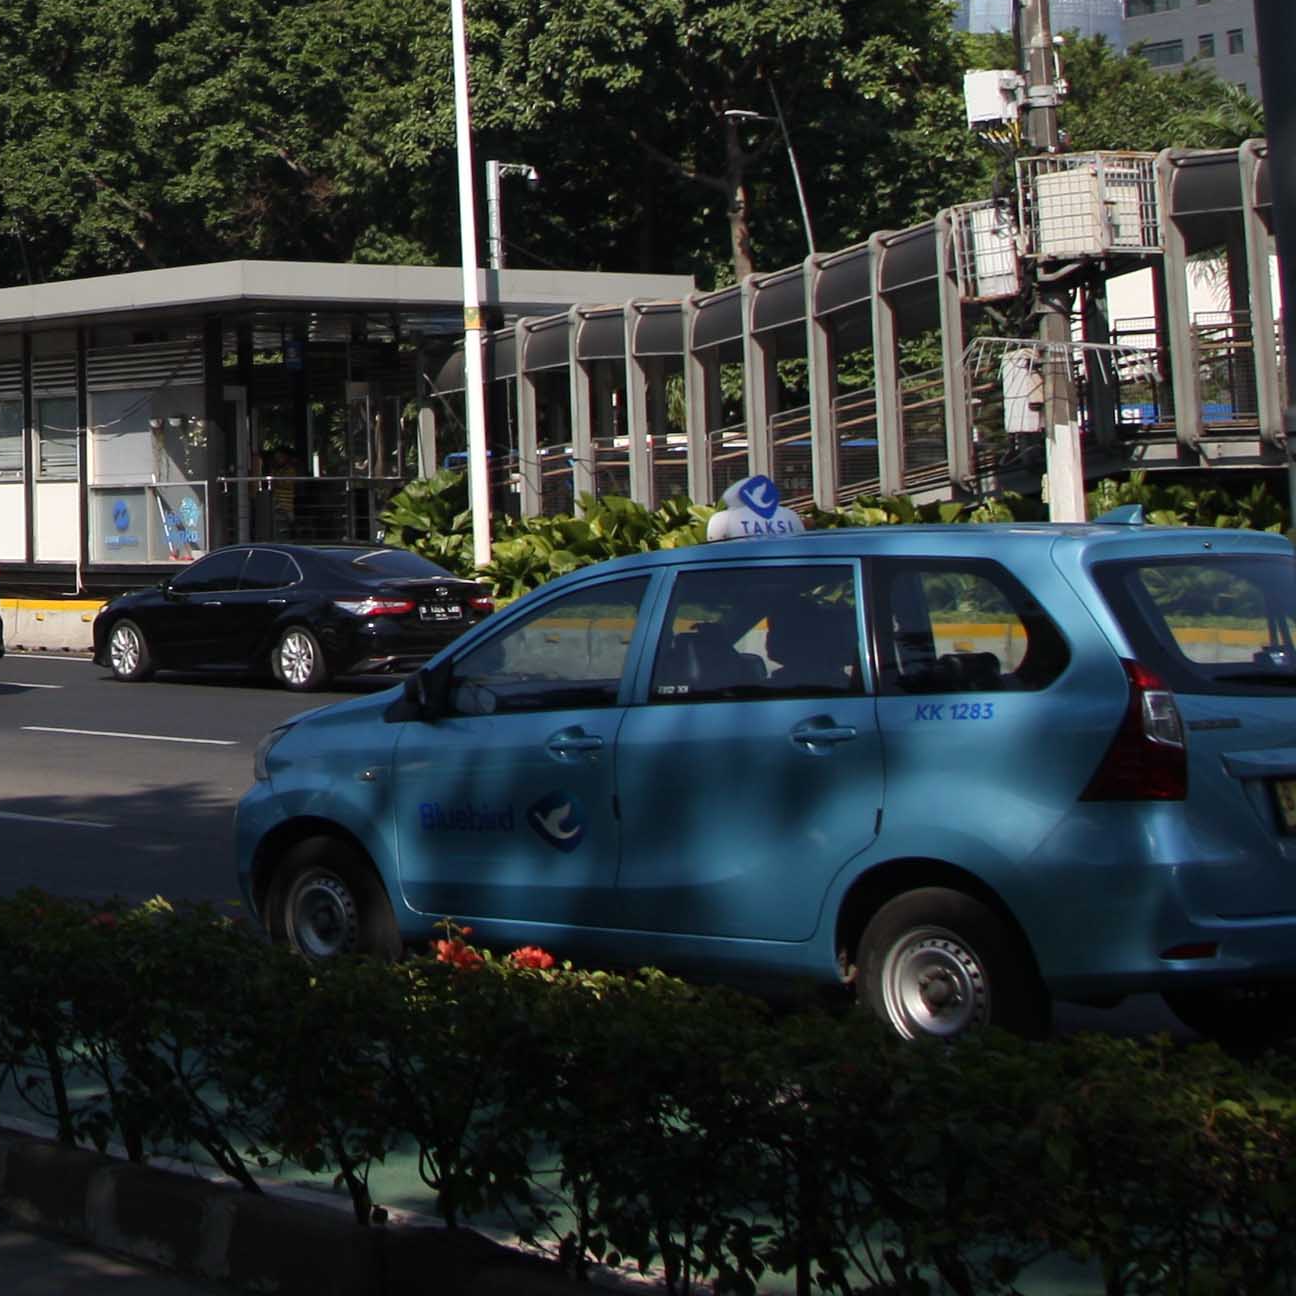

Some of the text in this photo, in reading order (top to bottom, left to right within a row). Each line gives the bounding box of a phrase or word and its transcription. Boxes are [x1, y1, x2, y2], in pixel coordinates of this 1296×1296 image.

[741, 520, 794, 536] TAKSI
[915, 703, 994, 721] KK 1283
[418, 801, 514, 833] Bluebird
